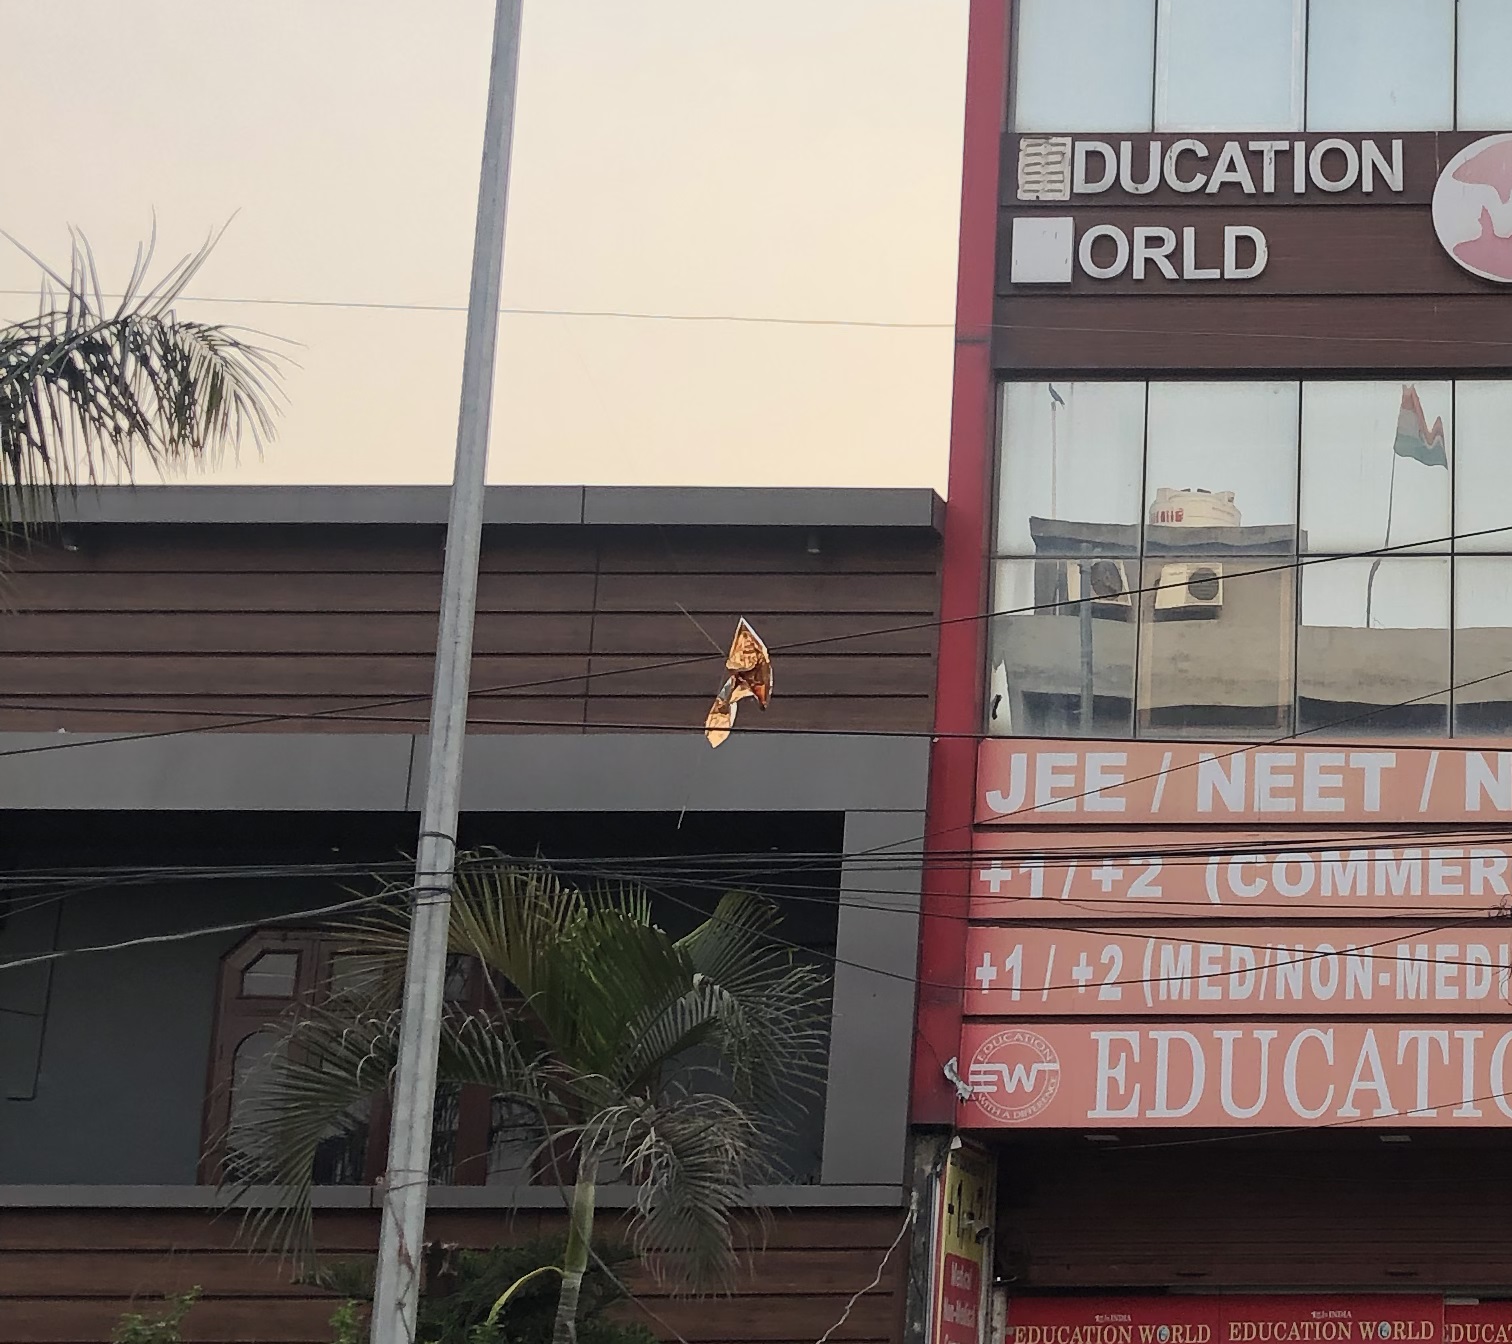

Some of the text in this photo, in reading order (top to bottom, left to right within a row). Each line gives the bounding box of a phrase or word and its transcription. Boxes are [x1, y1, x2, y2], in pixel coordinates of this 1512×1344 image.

[985, 752, 1127, 814] JEE
[1197, 752, 1397, 813] NEET
[1014, 1324, 1211, 1344] EDUCATION WORLD
[1228, 1320, 1434, 1341] EDUCATION WORLD
